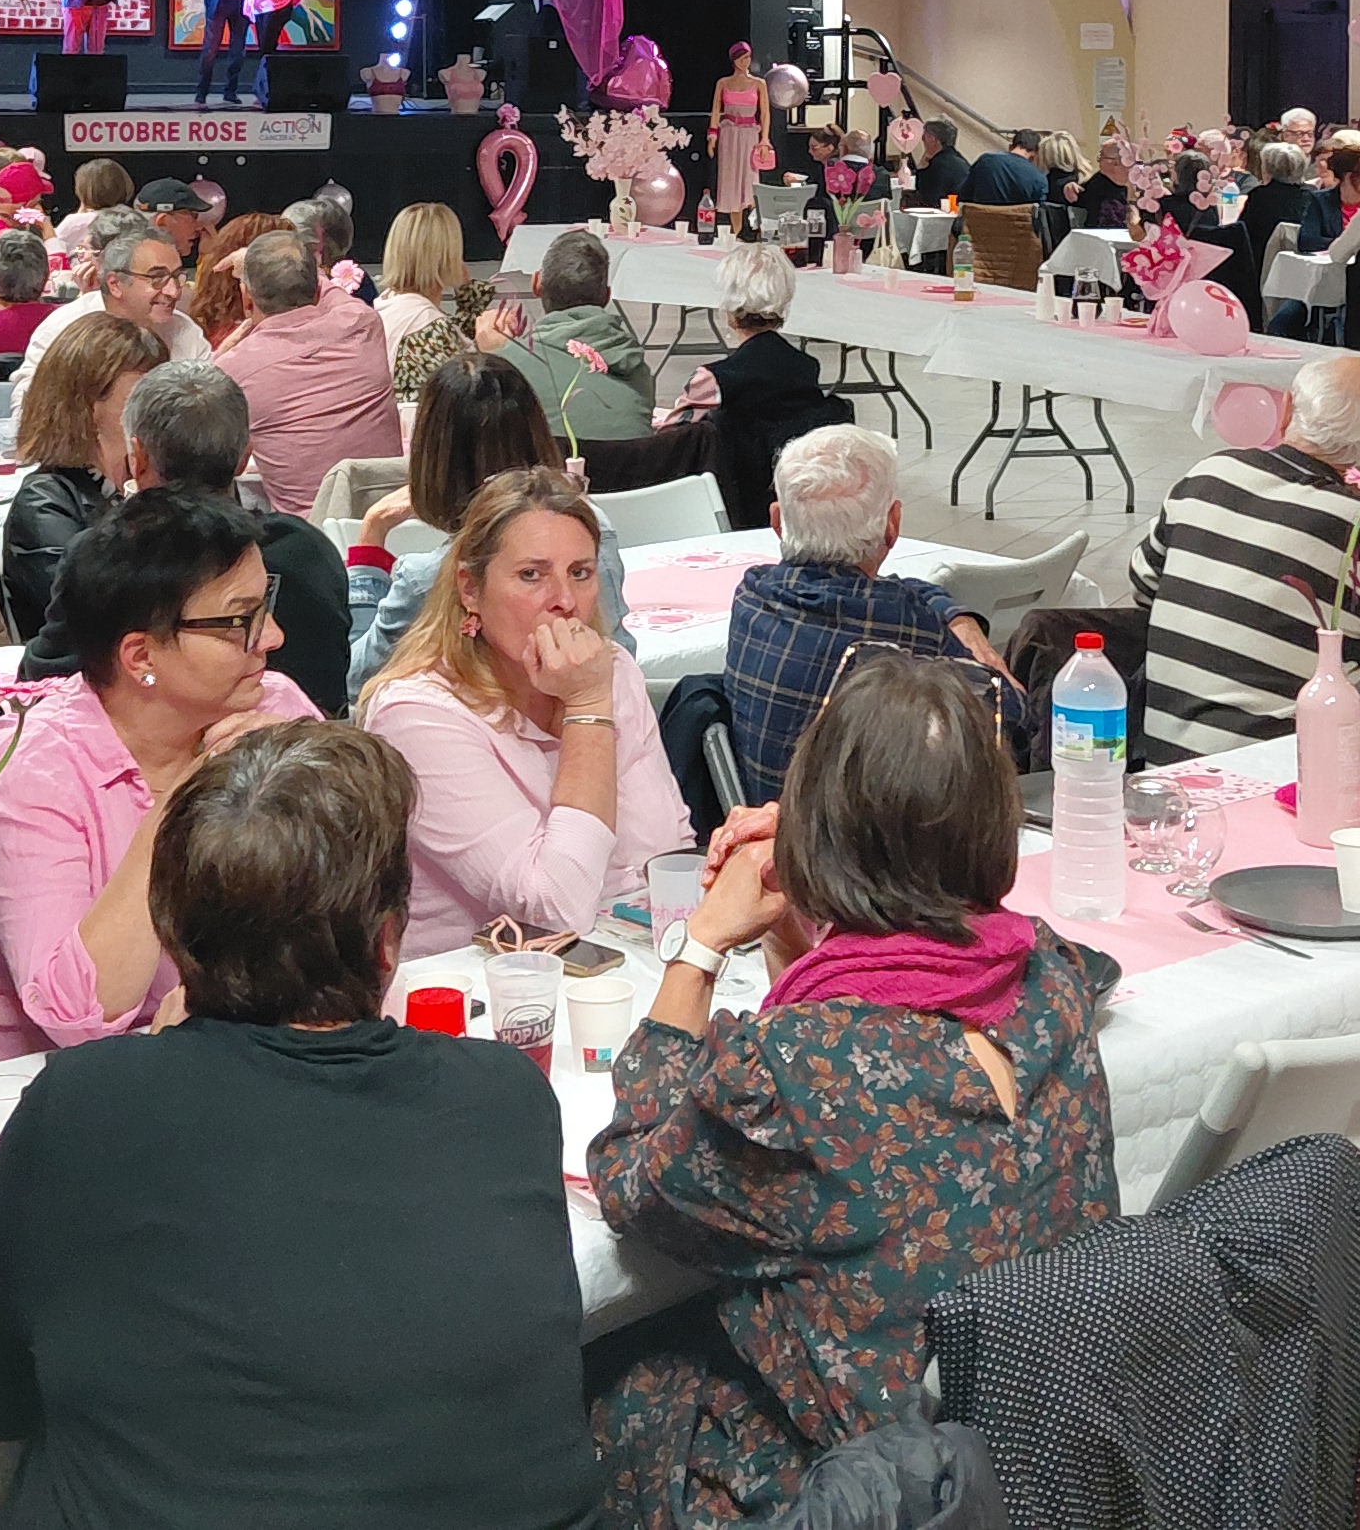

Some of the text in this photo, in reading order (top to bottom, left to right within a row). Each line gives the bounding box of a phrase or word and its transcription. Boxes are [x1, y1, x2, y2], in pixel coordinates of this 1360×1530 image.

[71, 121, 248, 142] OCTOBRE ROSE
[259, 118, 322, 134] ACTION
